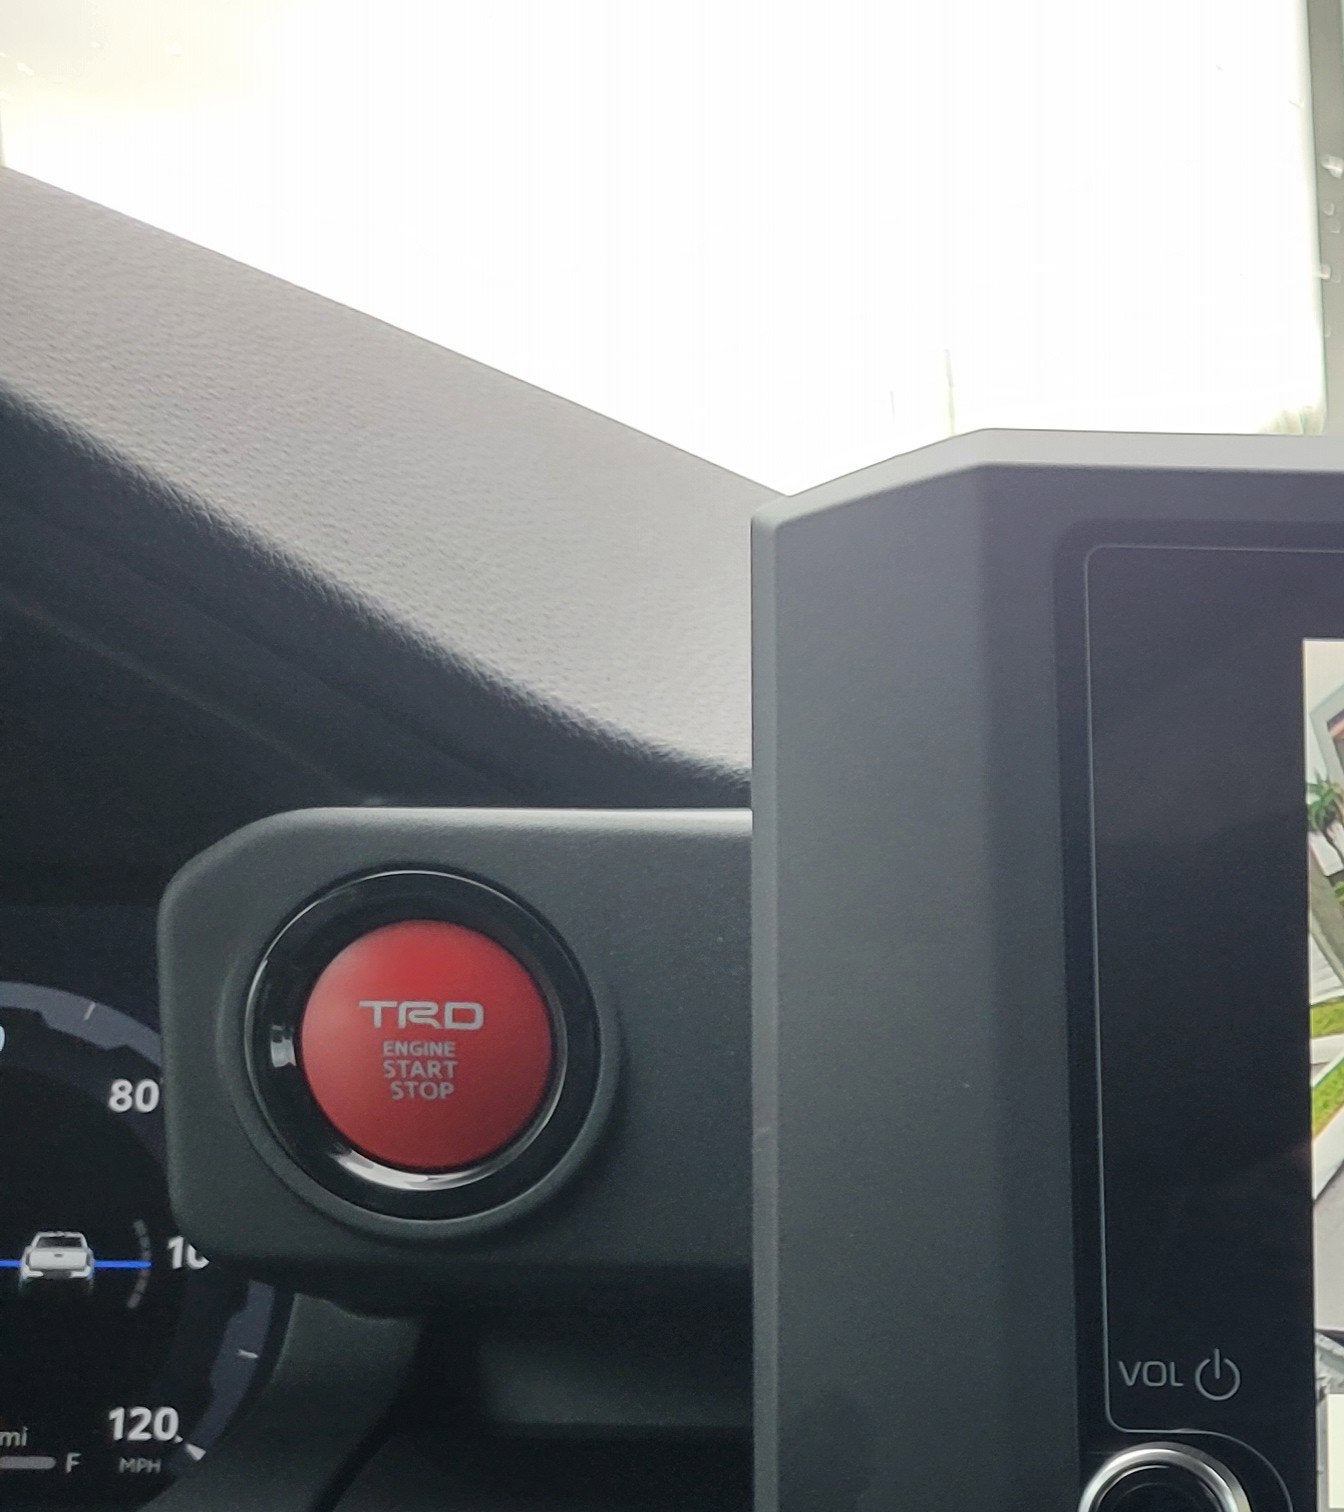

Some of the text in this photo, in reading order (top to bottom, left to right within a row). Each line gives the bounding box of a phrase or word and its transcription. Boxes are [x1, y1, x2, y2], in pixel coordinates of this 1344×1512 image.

[359, 1000, 485, 1031] TRD
[383, 1040, 456, 1058] ENGINE
[382, 1060, 458, 1079] START
[108, 1078, 160, 1113] 80
[390, 1081, 454, 1100] STOP
[1119, 1361, 1184, 1387] VOL
[108, 1406, 179, 1442] 120
[0, 1426, 28, 1447] mi
[66, 1452, 82, 1473] F
[119, 1457, 162, 1473] MPH
